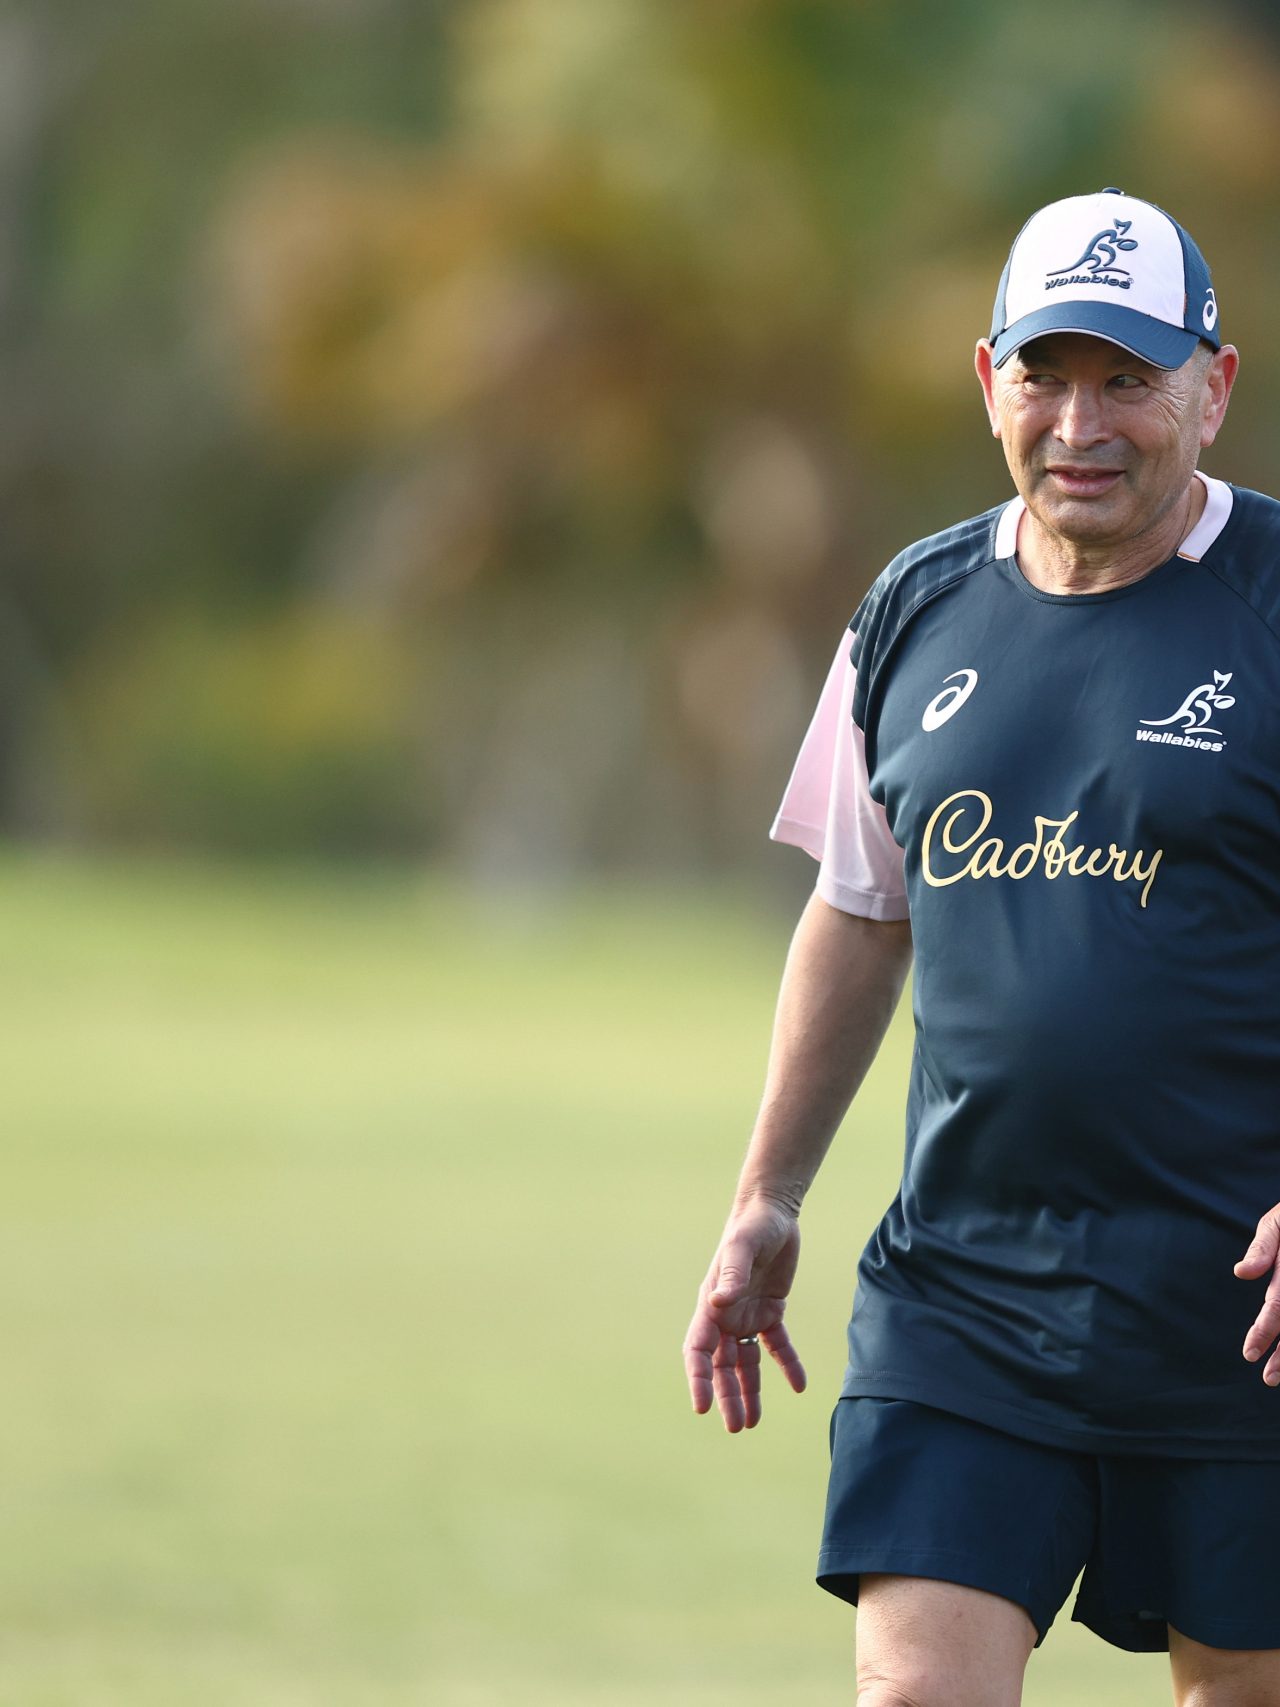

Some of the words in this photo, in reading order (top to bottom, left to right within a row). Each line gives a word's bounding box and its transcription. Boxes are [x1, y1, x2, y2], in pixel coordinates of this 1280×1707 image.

[1045, 275, 1131, 290] Wallabies
[1136, 729, 1223, 752] Wallabies
[921, 789, 1163, 908] Cadbury
